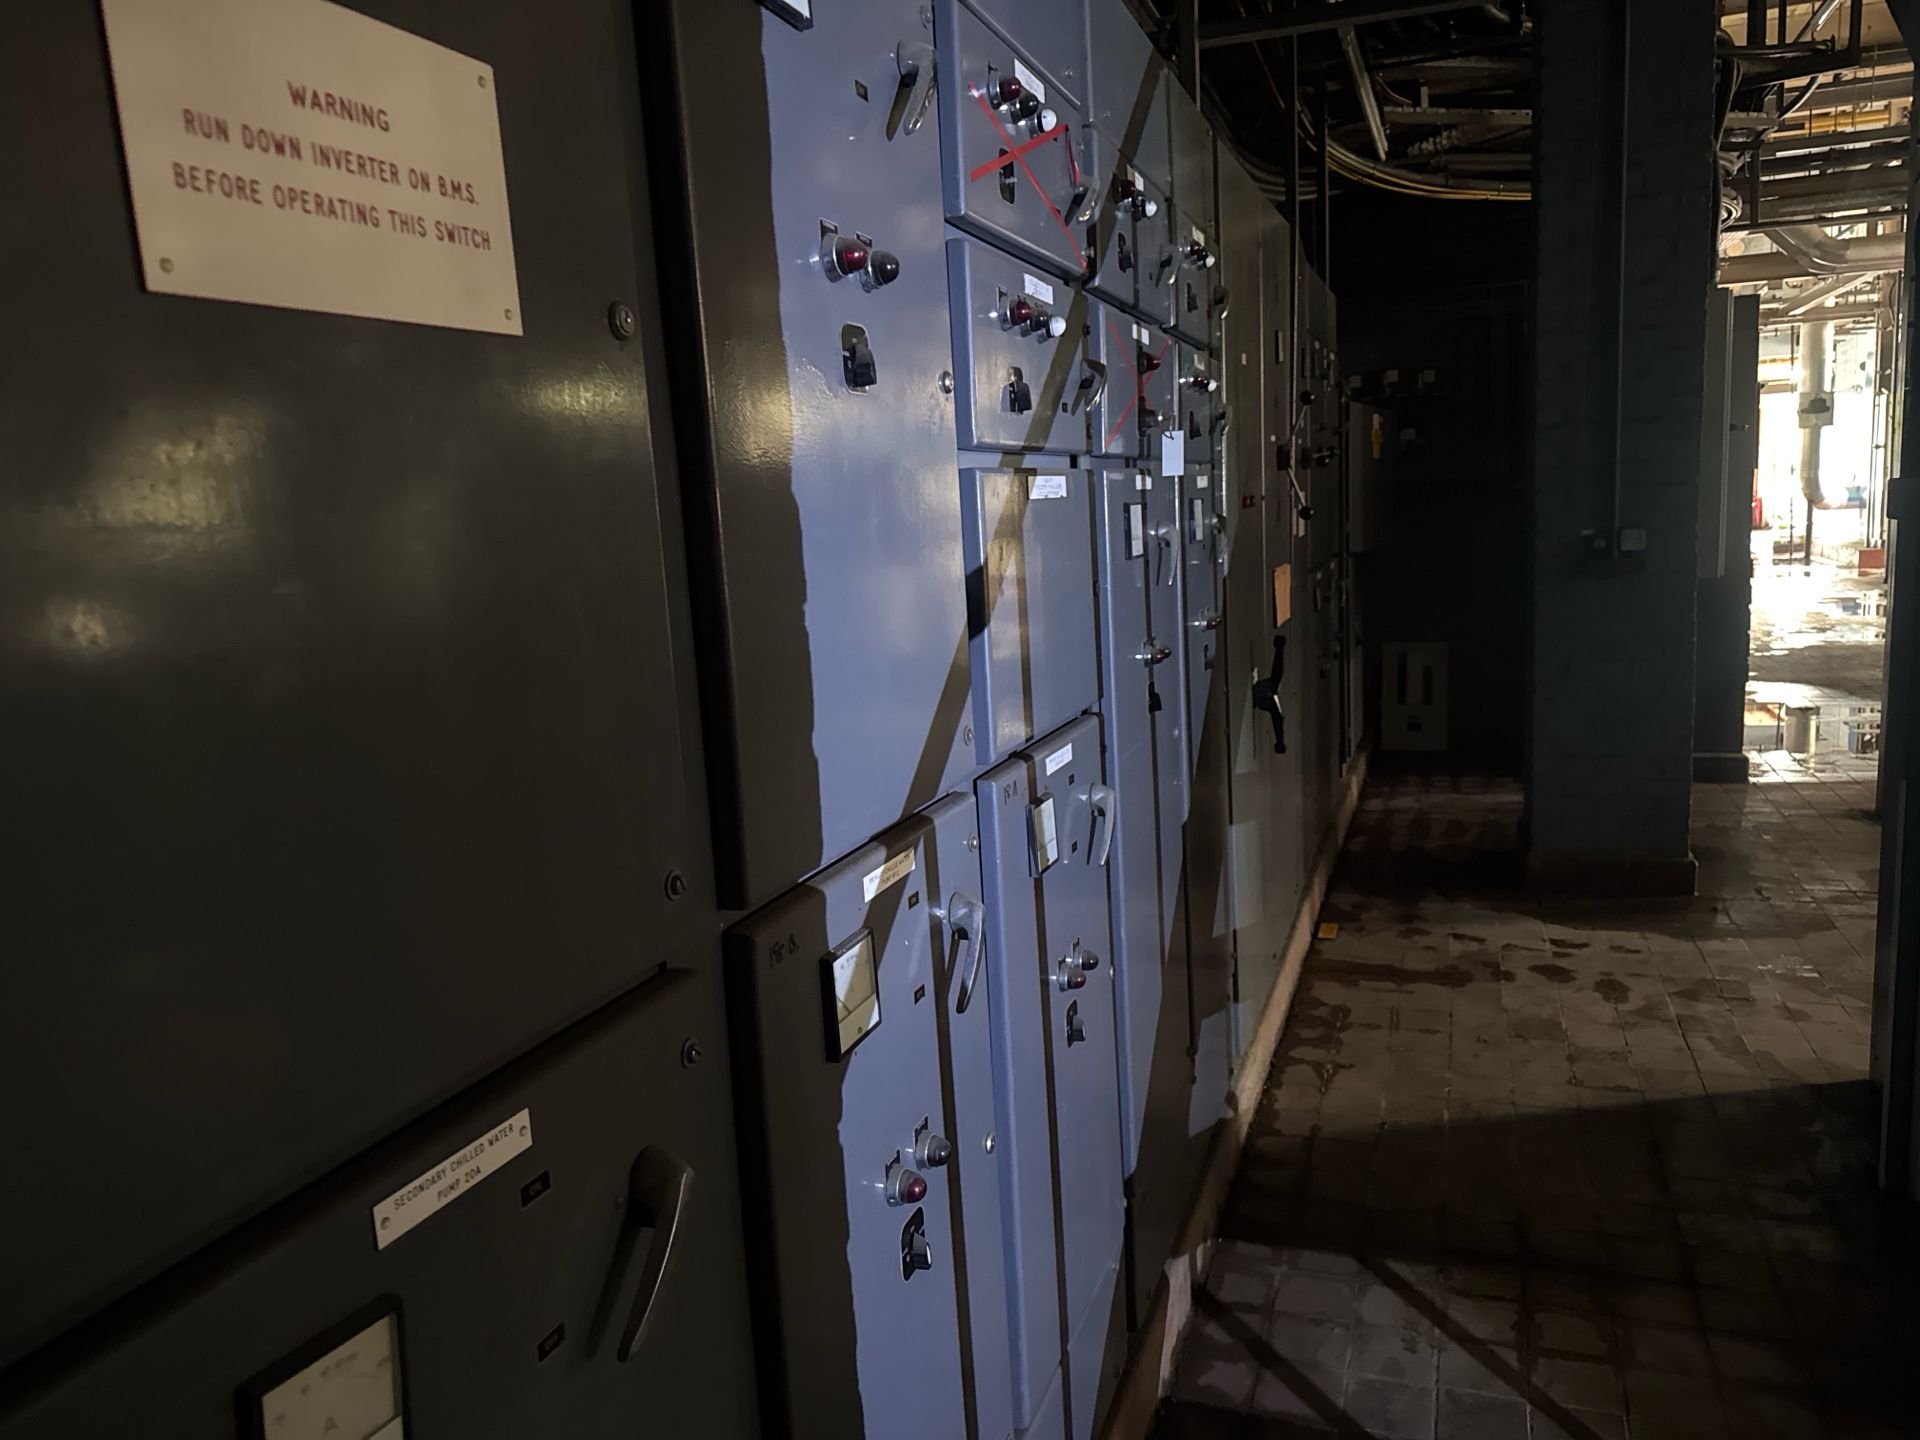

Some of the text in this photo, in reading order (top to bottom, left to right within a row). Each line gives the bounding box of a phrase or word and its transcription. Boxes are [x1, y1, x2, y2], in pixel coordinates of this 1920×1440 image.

[287, 81, 390, 133] WARNING
[182, 108, 479, 206] RUN DOWN INVERTER ON B.M.S.
[172, 162, 492, 251] BEFORE OPERATING THIS SWITCH
[393, 1122, 515, 1210] SECONDARY CHILLED WATER
[436, 1177, 461, 1202] PUMP
